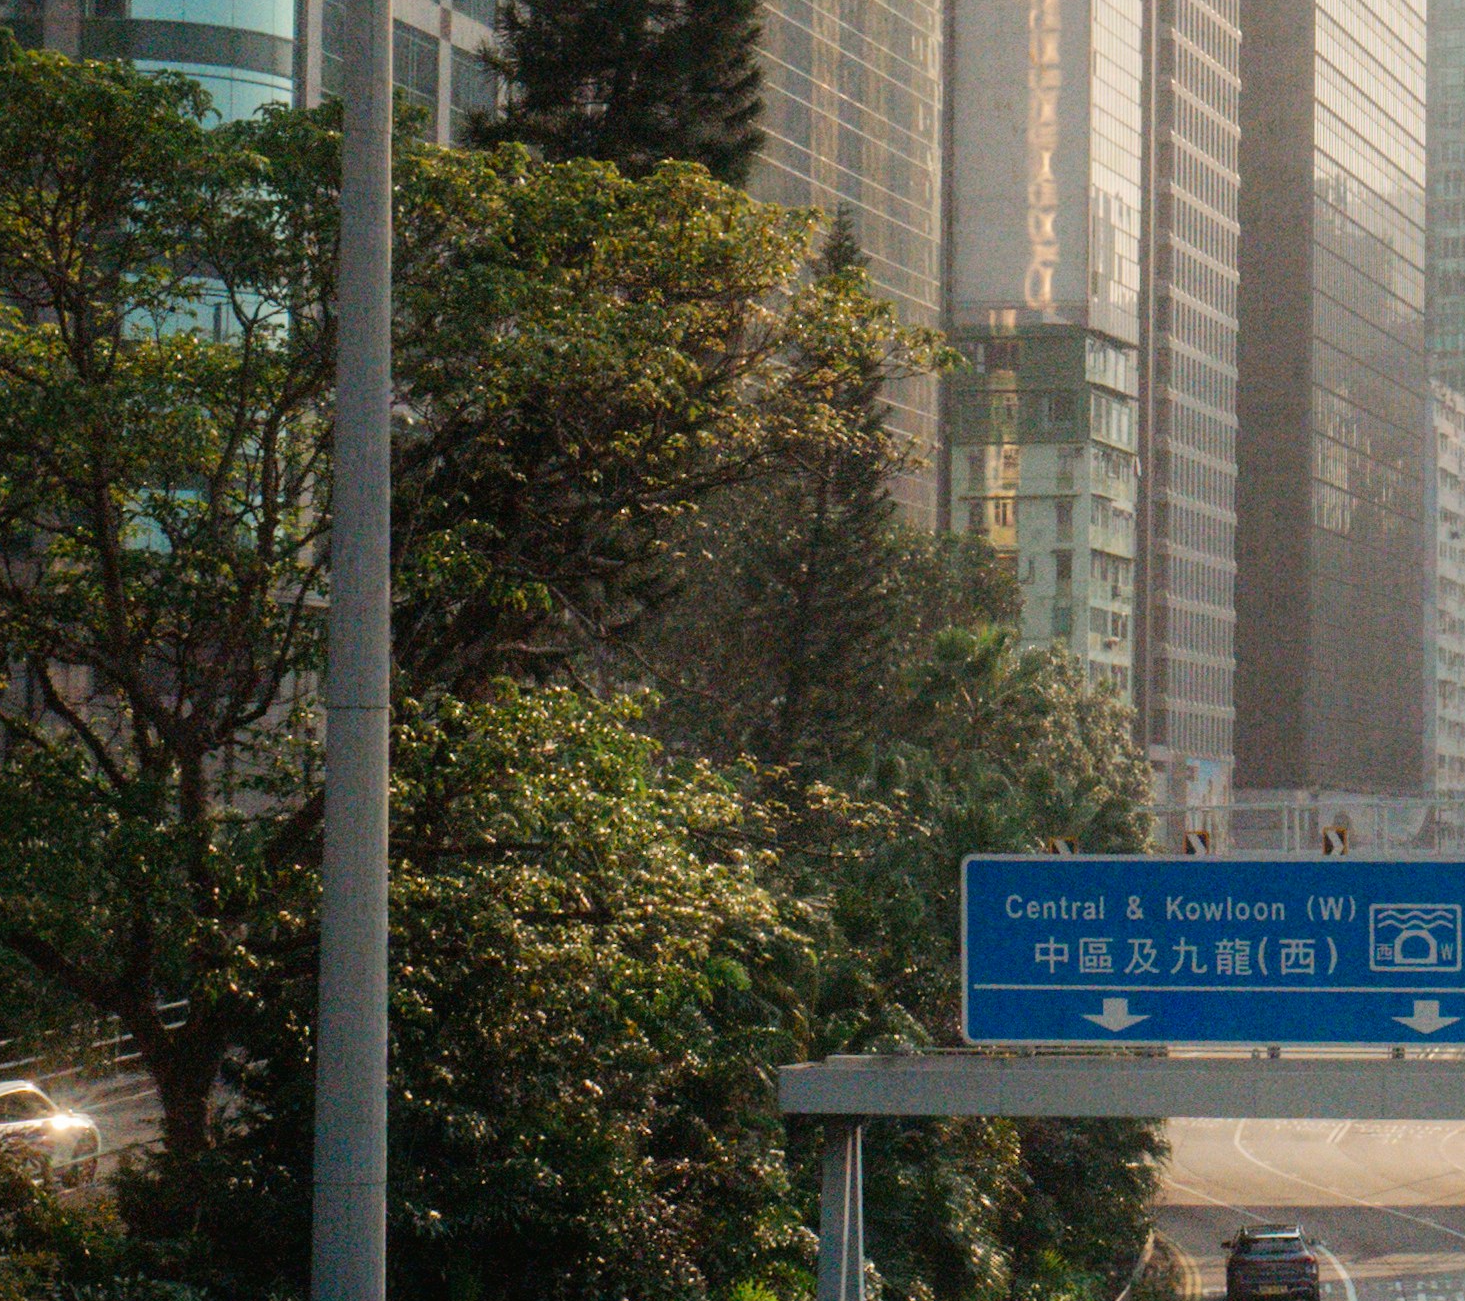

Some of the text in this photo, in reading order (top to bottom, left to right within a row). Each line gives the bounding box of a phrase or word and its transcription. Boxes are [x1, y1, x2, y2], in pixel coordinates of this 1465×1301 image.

[1005, 895, 1358, 924] Central & Kowloon (W)
[1034, 935, 1338, 977] 中區及九龍(西)
[1377, 943, 1394, 962] 西
[1440, 942, 1454, 960] W
